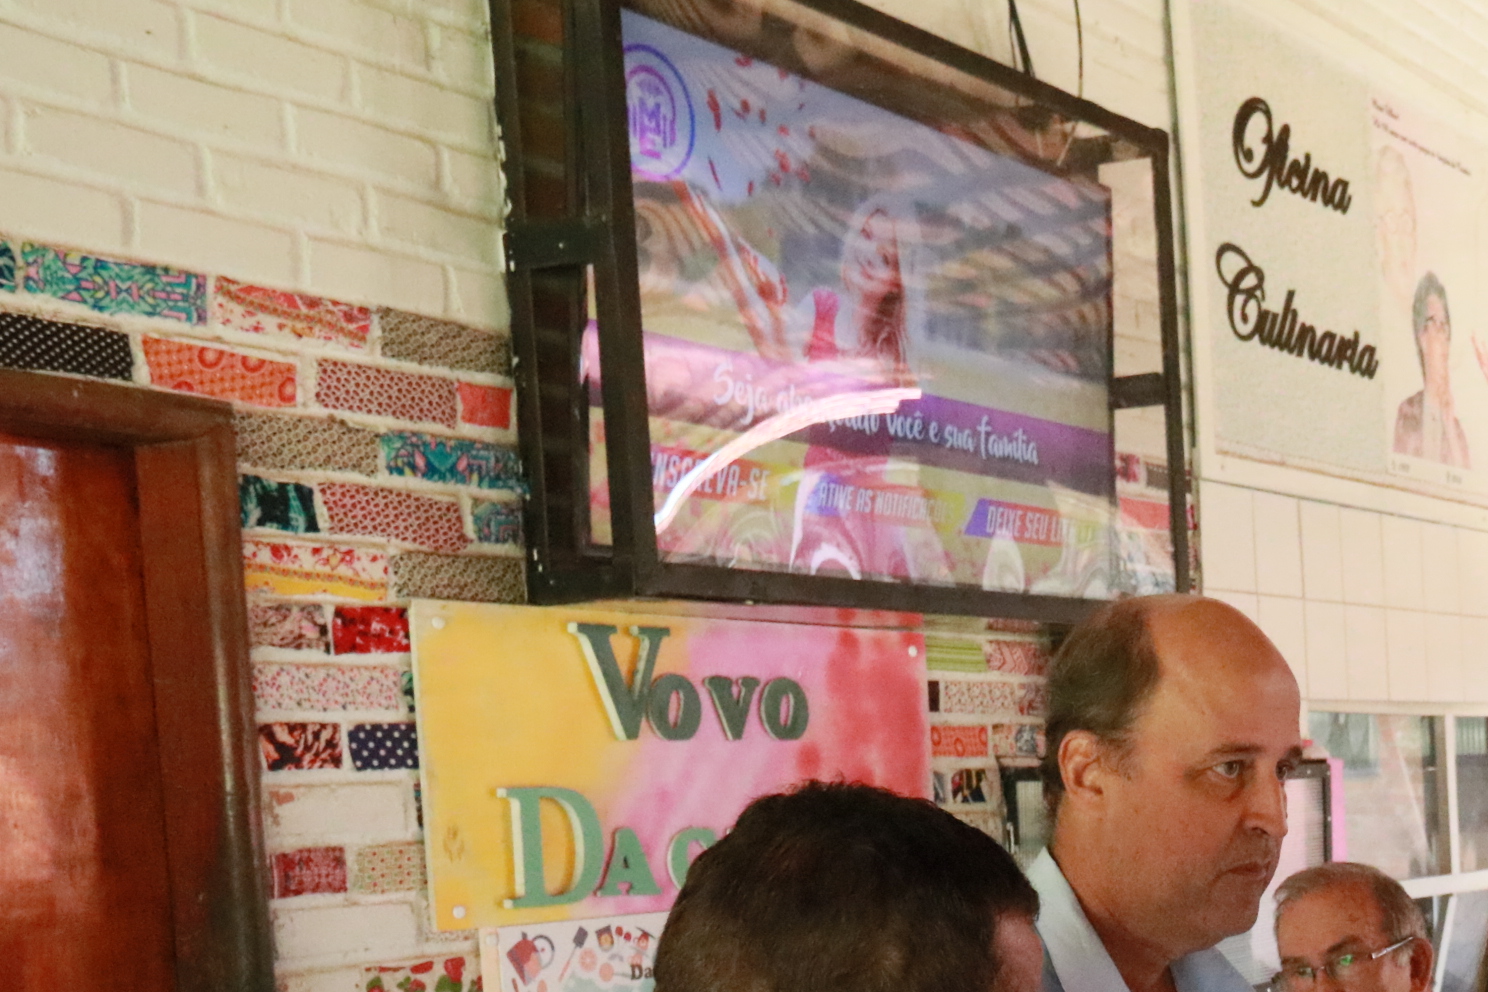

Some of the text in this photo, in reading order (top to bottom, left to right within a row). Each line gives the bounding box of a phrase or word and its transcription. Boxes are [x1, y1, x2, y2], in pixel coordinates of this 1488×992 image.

[1232, 97, 1352, 216] Oficina
[713, 358, 770, 426] Seja
[886, 411, 926, 441] você
[928, 419, 941, 443] e
[945, 423, 976, 451] sua
[856, 486, 873, 514] AS
[986, 505, 1022, 538] DEIXE
[1024, 510, 1050, 541] SEU
